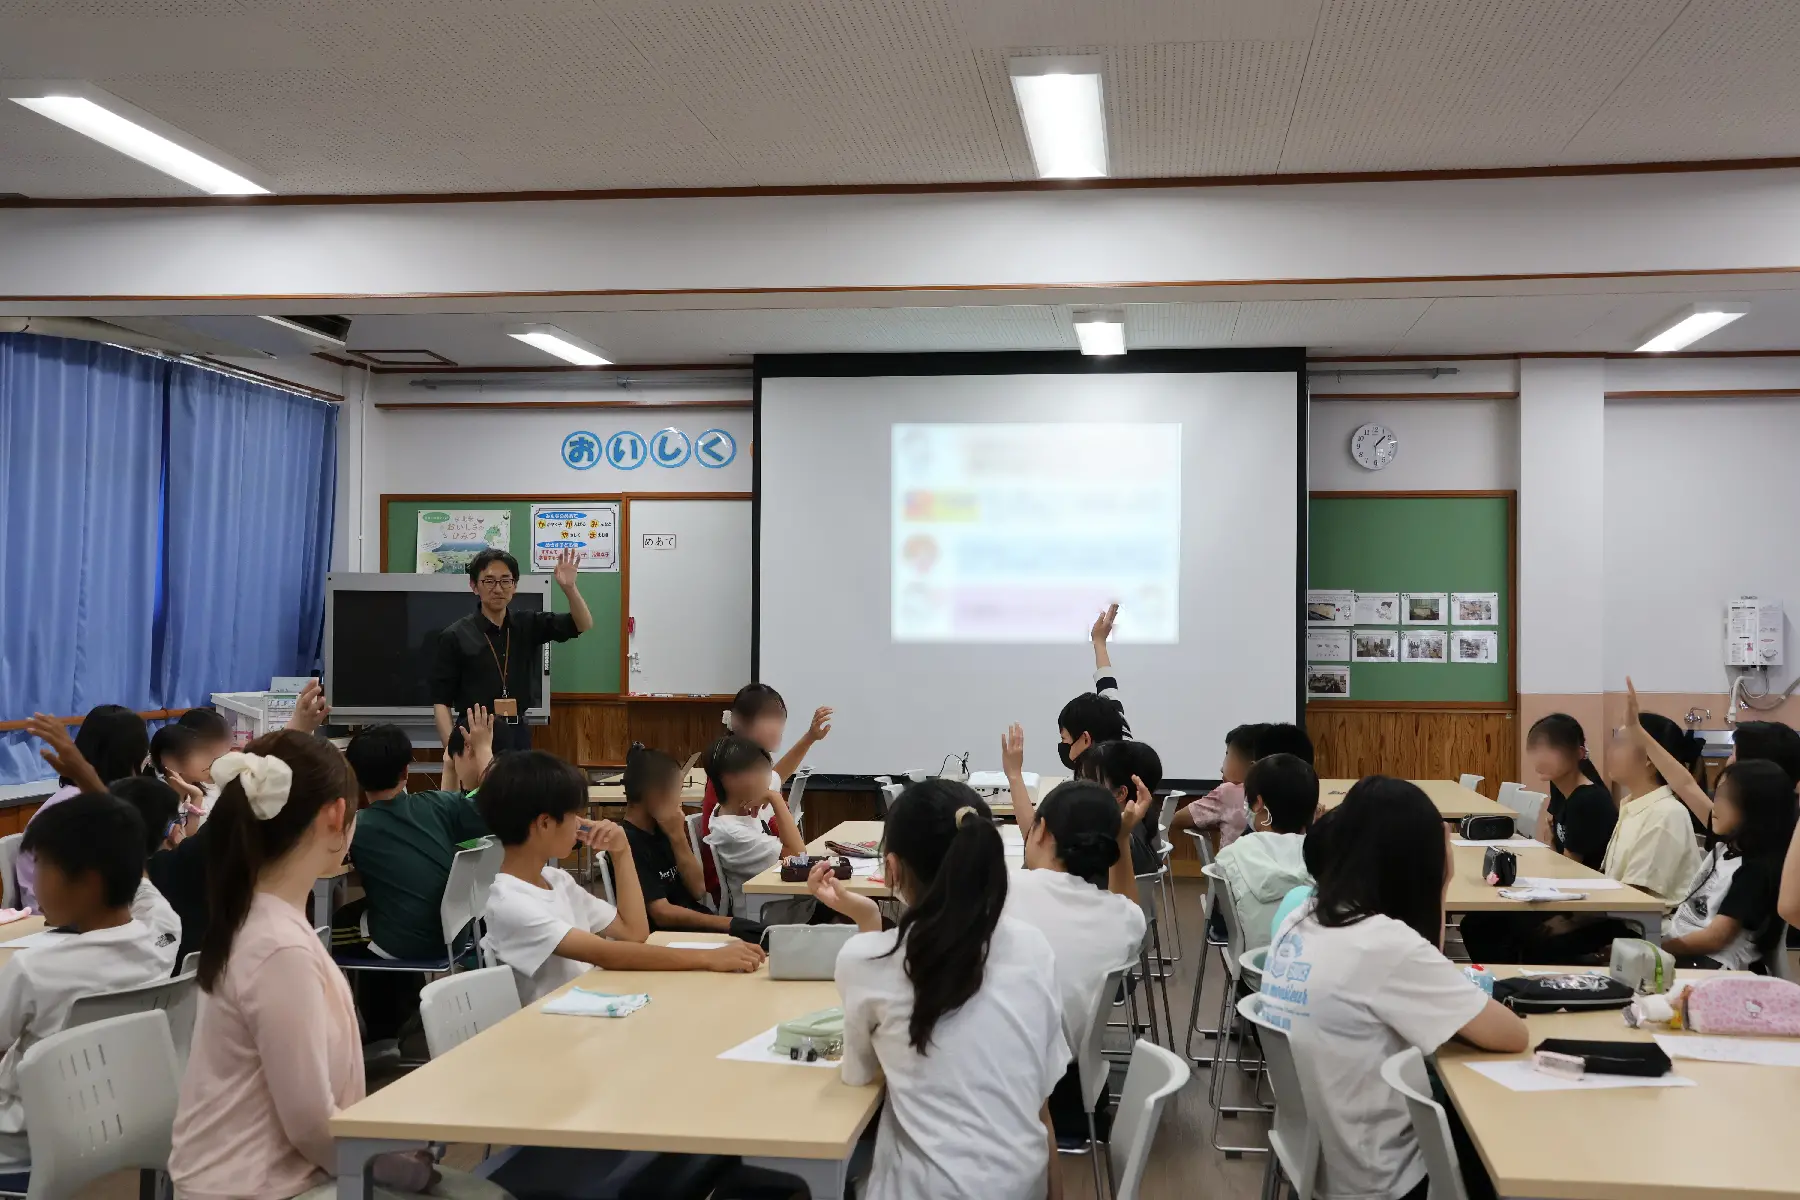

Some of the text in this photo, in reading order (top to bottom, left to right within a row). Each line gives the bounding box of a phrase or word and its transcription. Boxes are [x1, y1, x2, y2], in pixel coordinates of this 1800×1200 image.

[567, 436, 725, 463] おいしく
[644, 536, 674, 547] めあて
